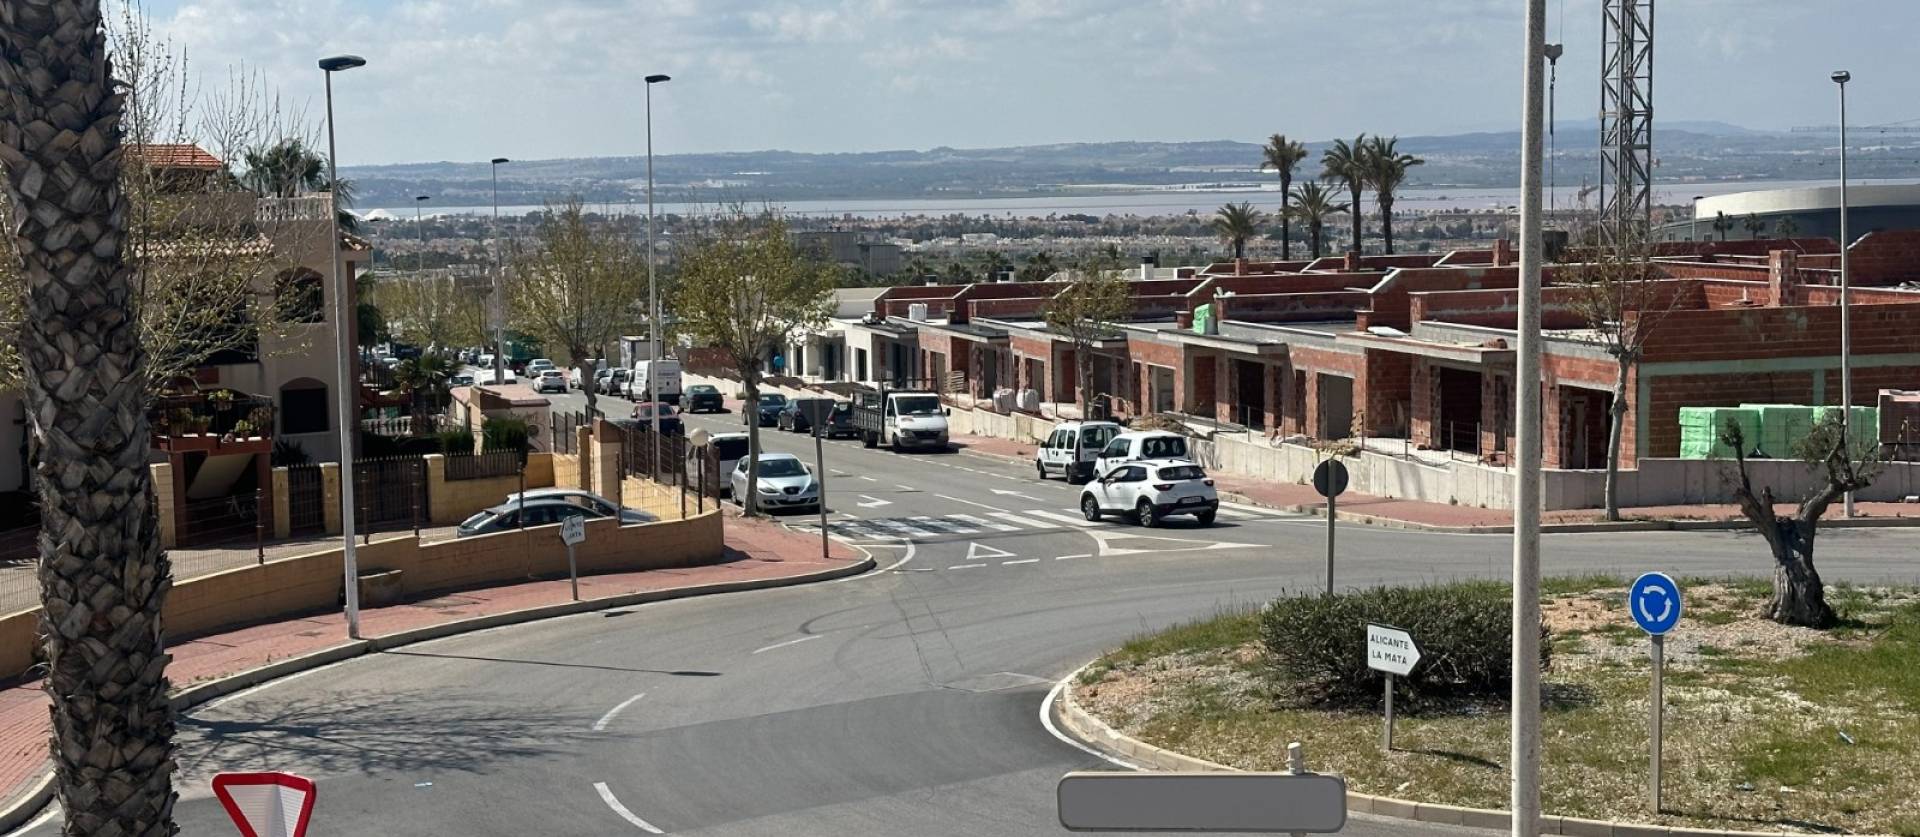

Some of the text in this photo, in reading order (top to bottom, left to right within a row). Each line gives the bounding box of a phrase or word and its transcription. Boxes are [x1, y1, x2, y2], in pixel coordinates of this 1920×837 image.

[1370, 634, 1409, 650] ALICANTE
[1372, 649, 1408, 664] LA MATA
